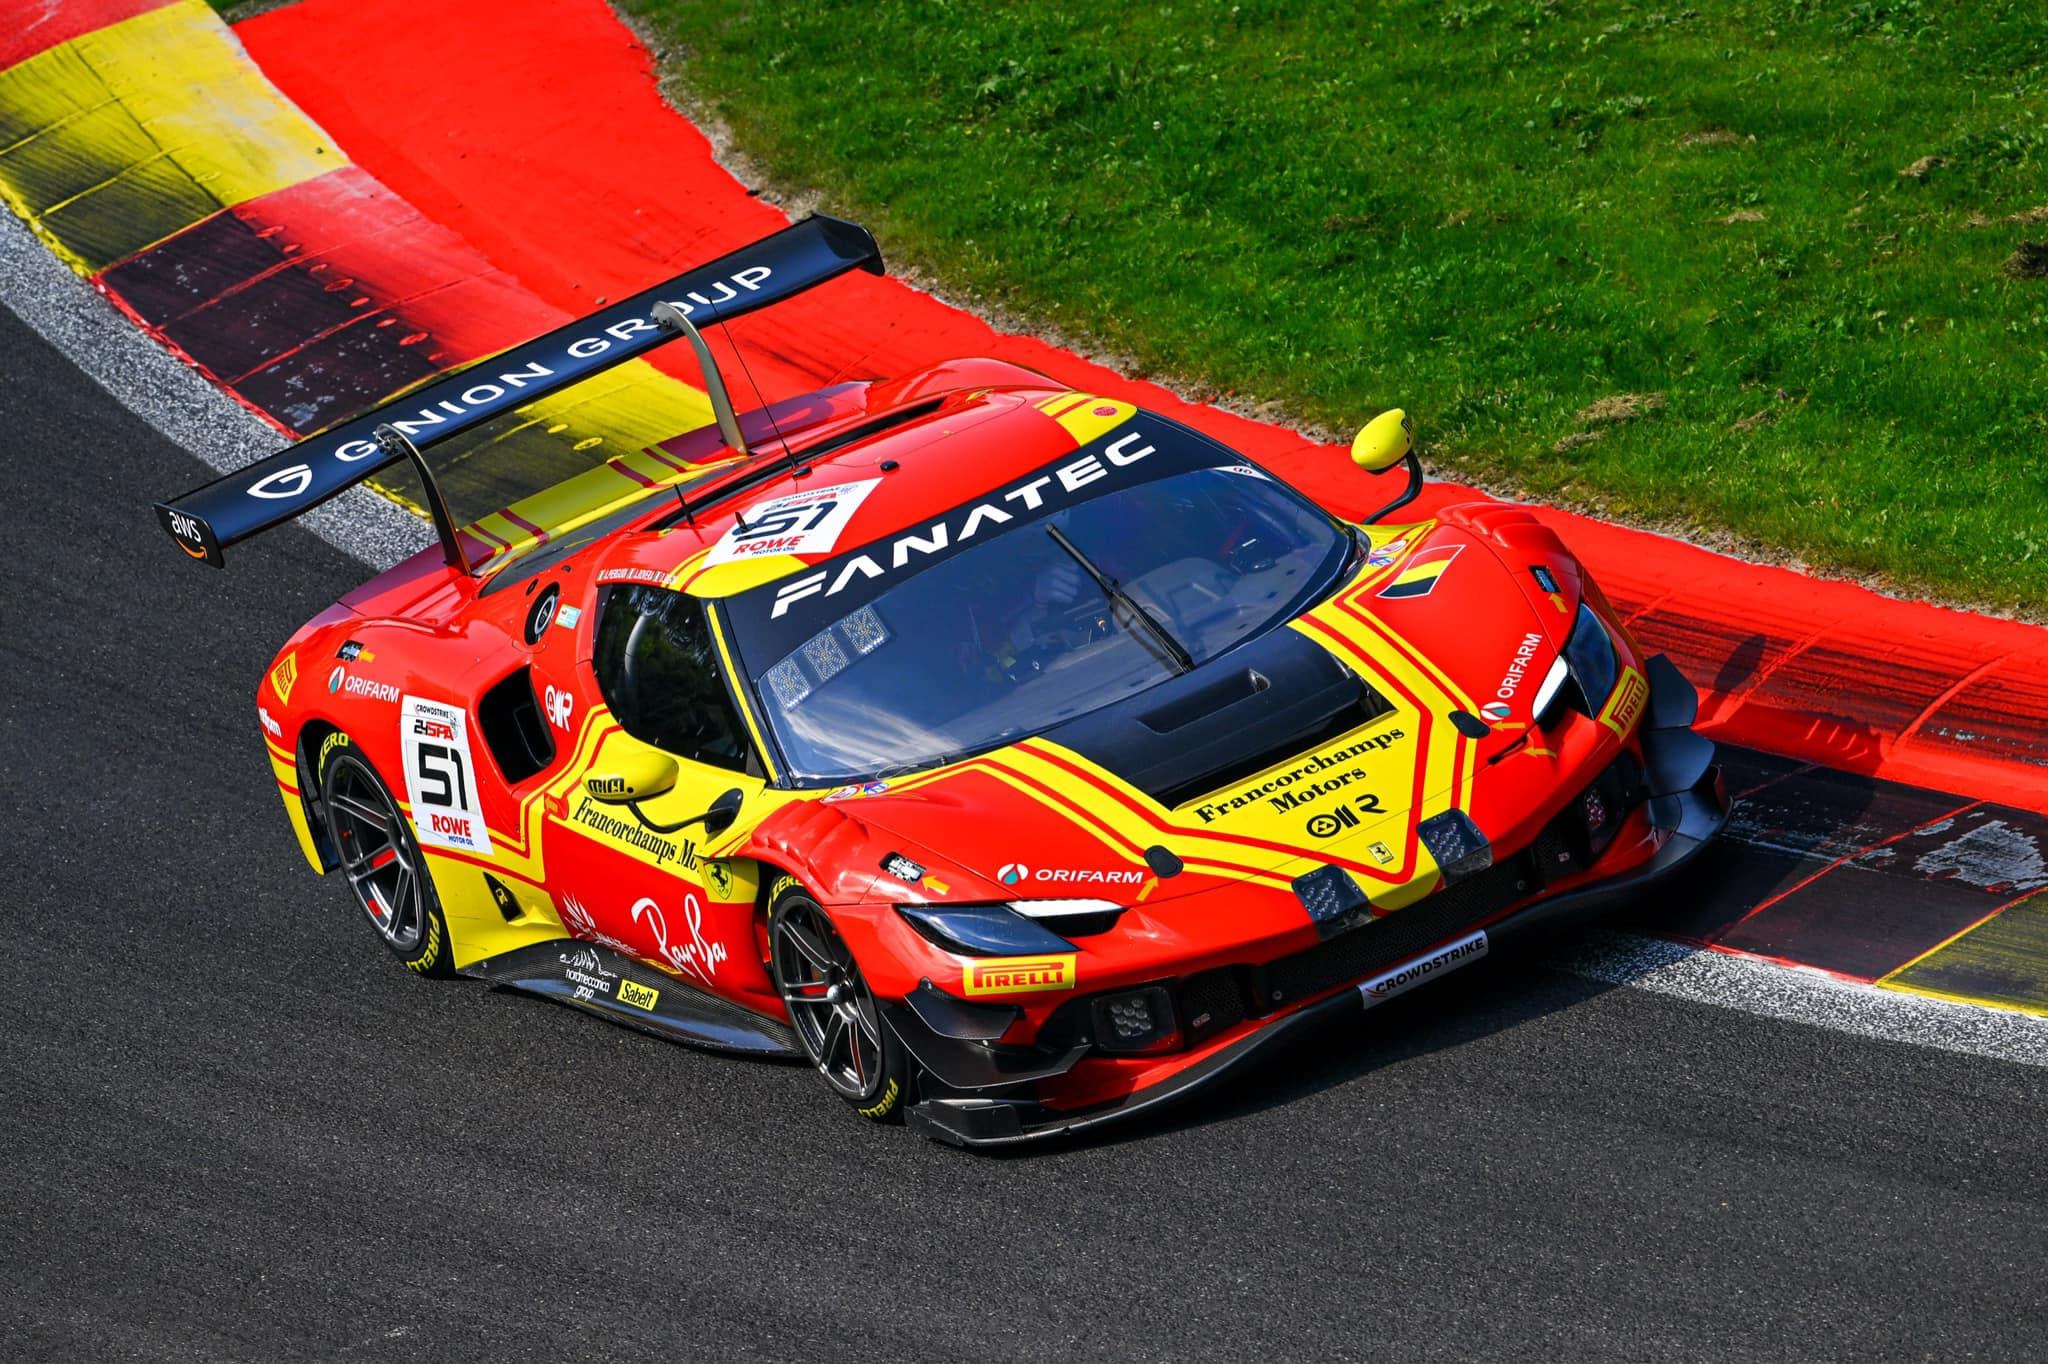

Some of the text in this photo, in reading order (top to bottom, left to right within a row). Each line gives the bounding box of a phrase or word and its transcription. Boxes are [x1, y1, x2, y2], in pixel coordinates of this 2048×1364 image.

[334, 361, 555, 462] GNION
[171, 511, 202, 543] aws
[731, 501, 838, 543] 51
[770, 431, 1157, 620] FANATEC
[732, 535, 805, 555] ROWE
[1497, 633, 1543, 699] ORIFARM
[345, 675, 400, 703] ORIFARM
[415, 703, 449, 719] CROWDSTRIKE
[418, 742, 468, 811] 51
[1194, 728, 1405, 824] Francorchamps
[1267, 767, 1367, 815] Motors
[430, 813, 472, 838] ROWE
[448, 835, 474, 846] MOTOR OIL
[573, 796, 677, 864] Francorchamps
[1035, 869, 1143, 884] ORIFARM
[405, 912, 440, 973] PIRELLI
[973, 961, 1064, 989] PIRELLI
[1375, 937, 1485, 994] CROWDSTRIKE
[573, 985, 594, 1003] group
[622, 983, 653, 1009] Sabelt
